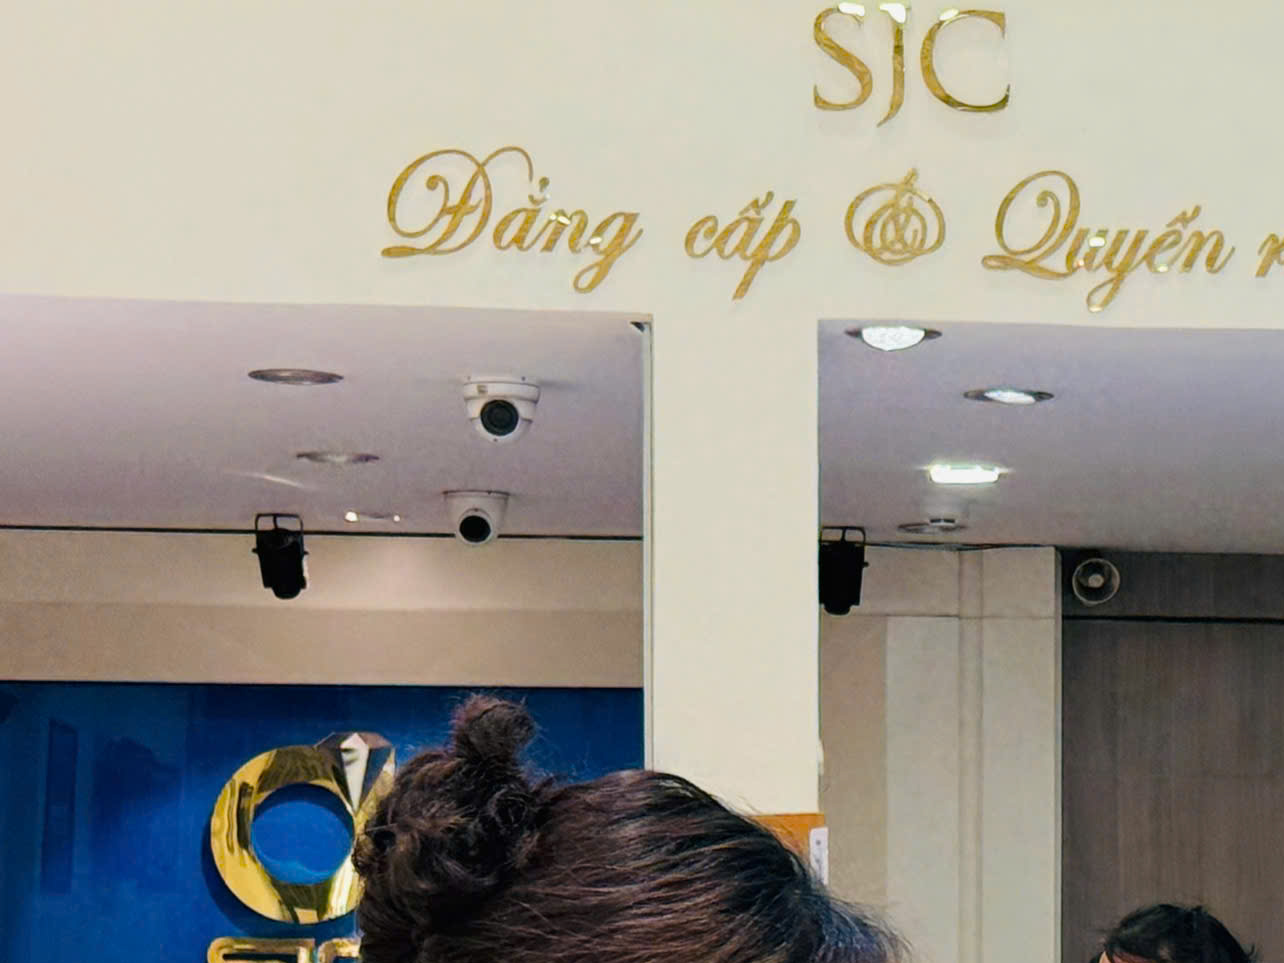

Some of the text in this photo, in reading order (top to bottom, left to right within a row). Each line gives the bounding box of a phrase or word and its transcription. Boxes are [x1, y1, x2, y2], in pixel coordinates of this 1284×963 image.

[813, 2, 1011, 128] SJC
[381, 146, 644, 294] Đẳng
[684, 190, 801, 301] cấp
[981, 170, 1236, 313] Quyến
